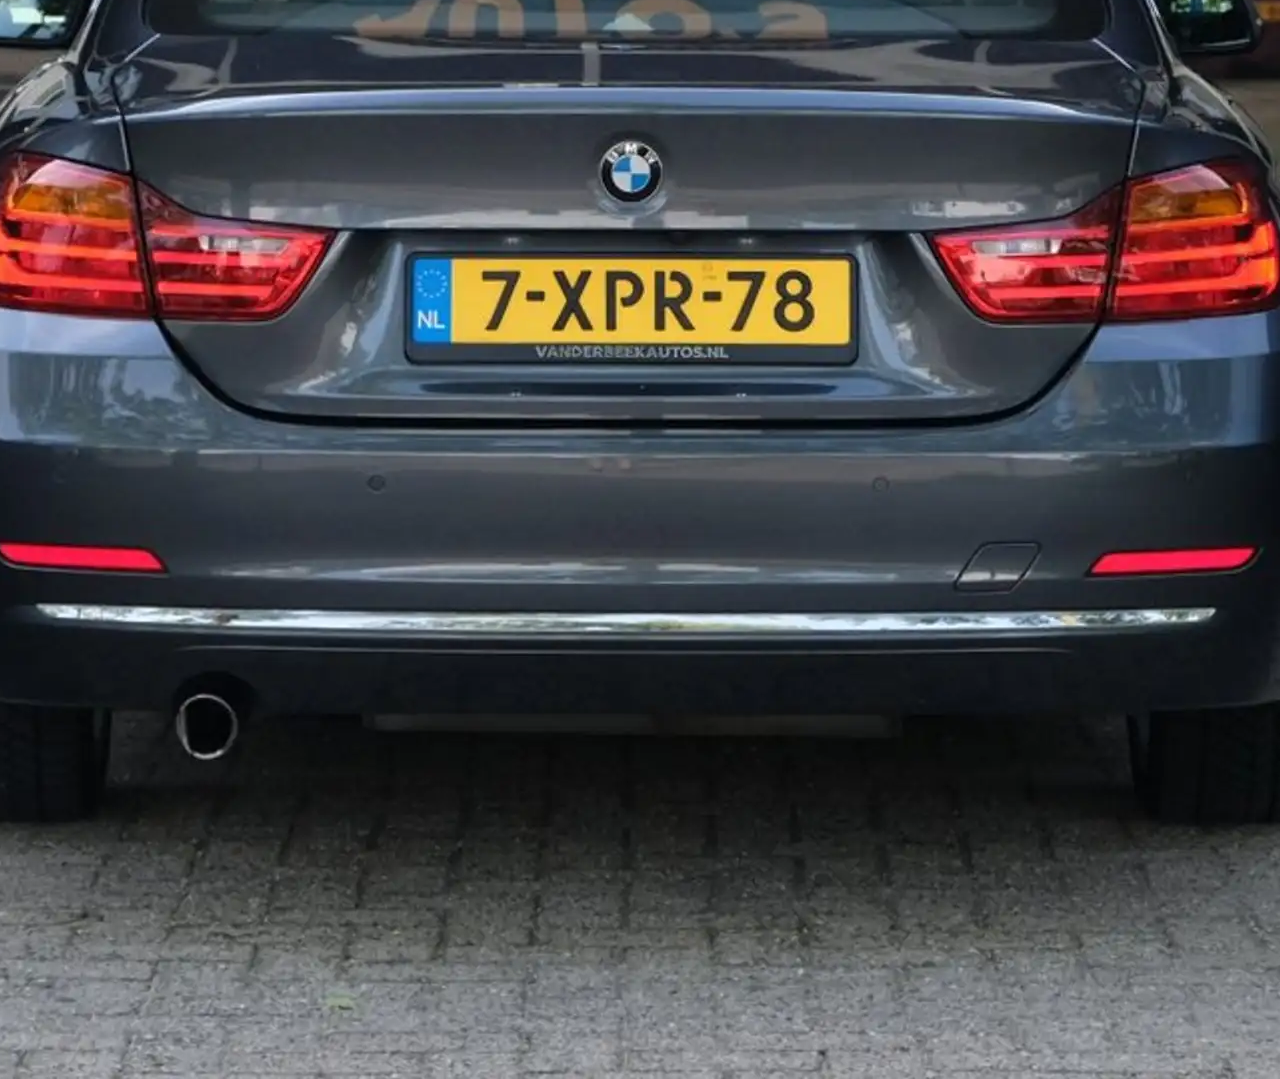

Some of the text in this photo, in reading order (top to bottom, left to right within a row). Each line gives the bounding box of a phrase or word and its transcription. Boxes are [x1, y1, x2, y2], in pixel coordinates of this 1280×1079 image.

[481, 270, 815, 332] 7-XPR-78
[417, 311, 445, 329] NL
[535, 345, 729, 359] VANDERBEEKAUTOS.NL
